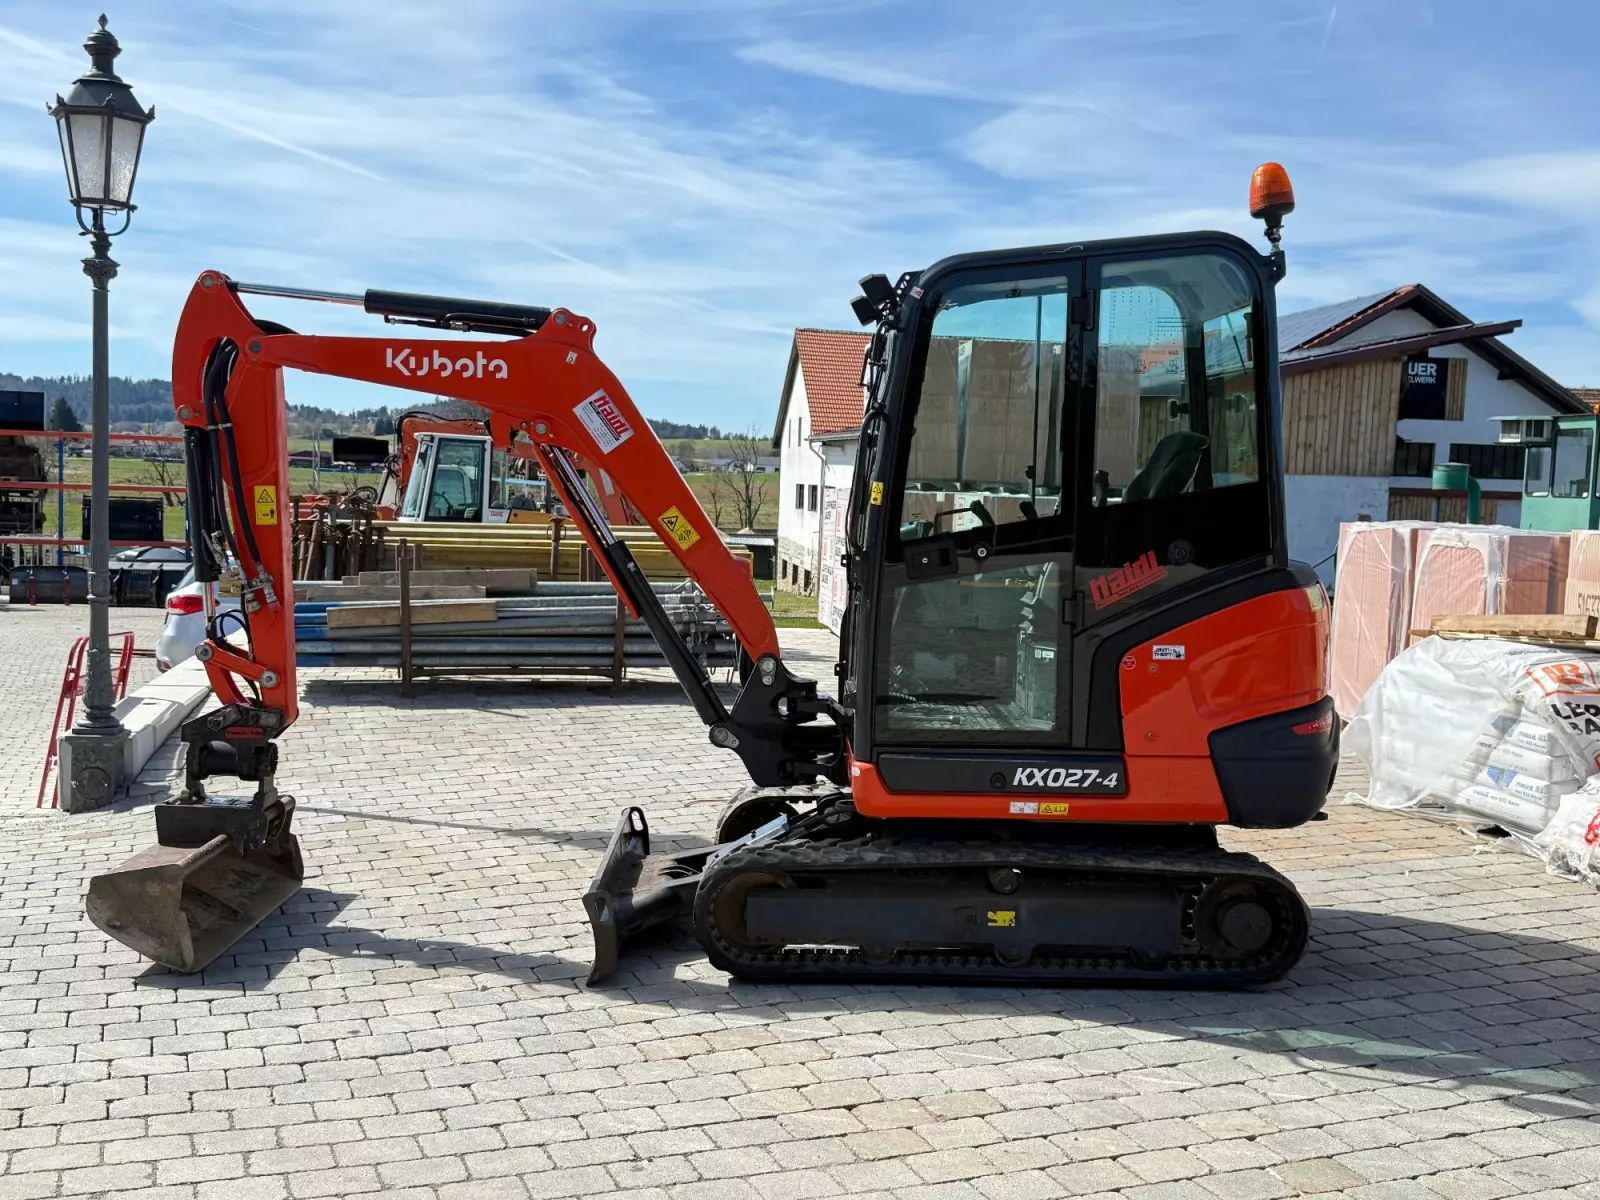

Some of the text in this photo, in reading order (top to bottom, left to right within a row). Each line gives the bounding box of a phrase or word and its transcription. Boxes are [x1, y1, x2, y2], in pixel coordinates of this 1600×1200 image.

[385, 347, 508, 379] Kubota
[1408, 362, 1437, 376] UER
[1012, 767, 1118, 788] KX027-4
